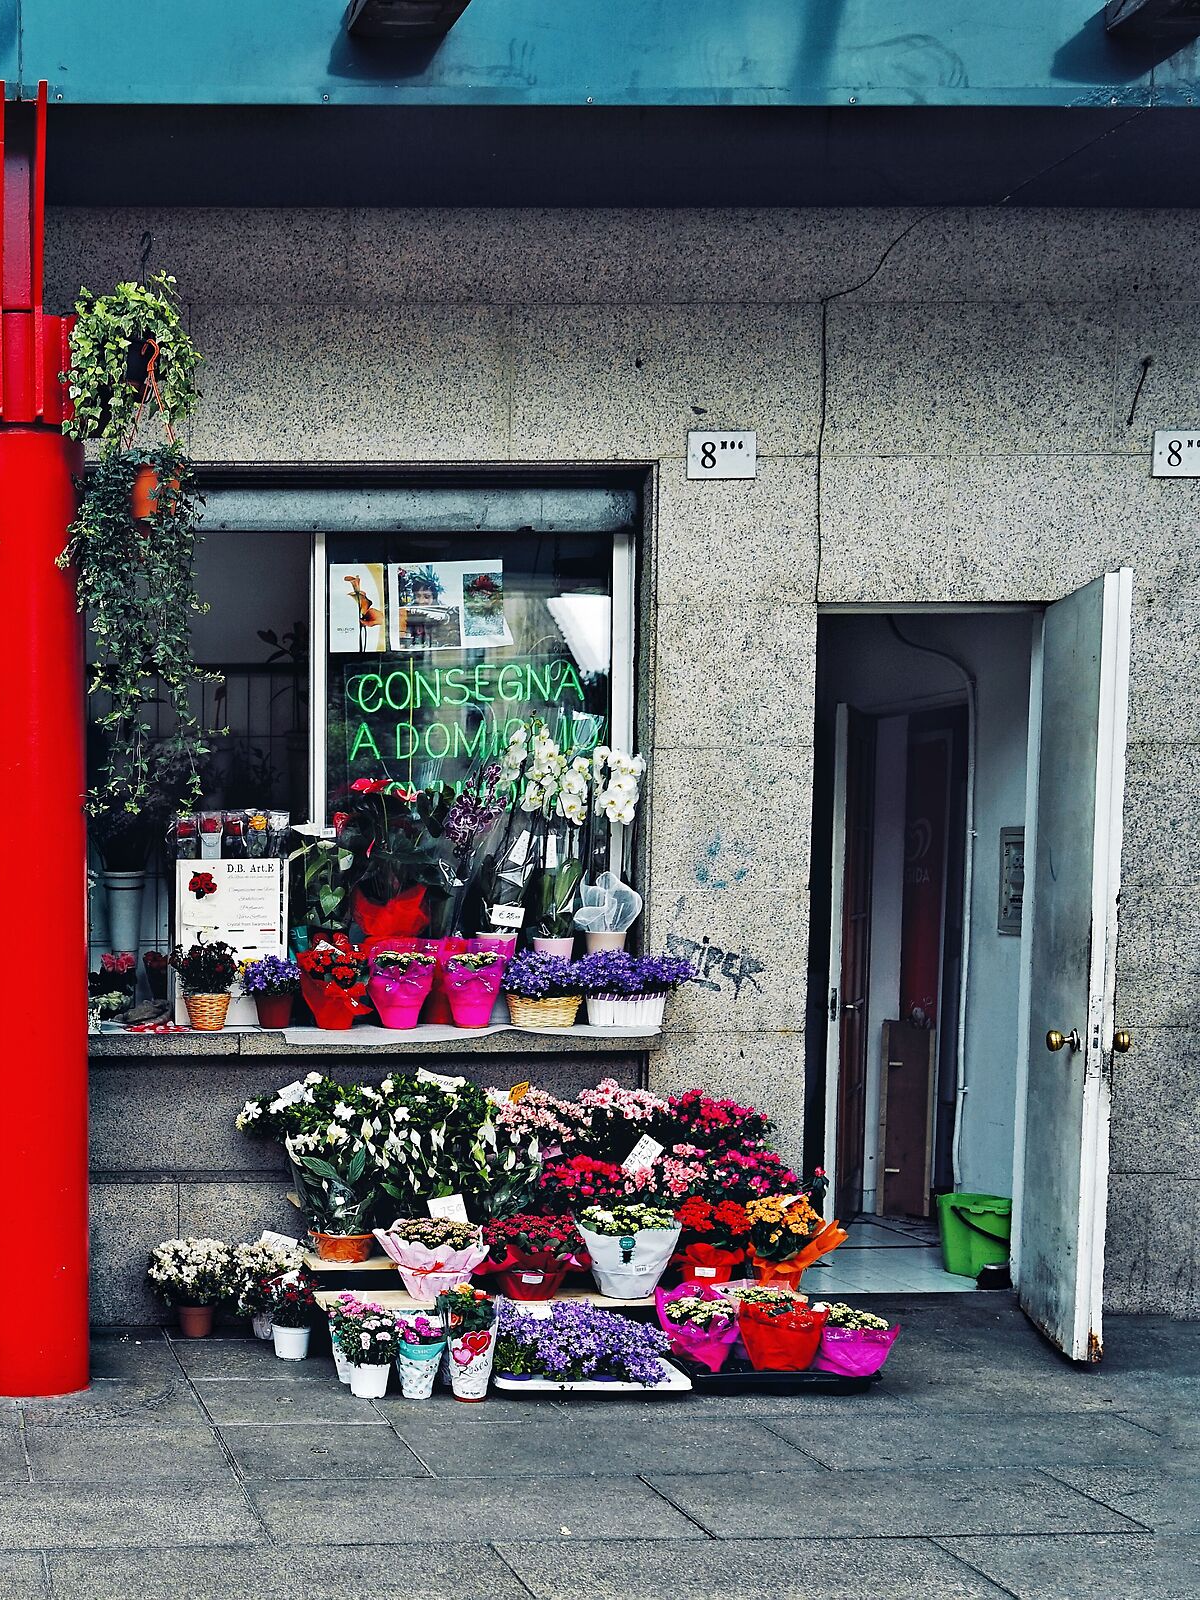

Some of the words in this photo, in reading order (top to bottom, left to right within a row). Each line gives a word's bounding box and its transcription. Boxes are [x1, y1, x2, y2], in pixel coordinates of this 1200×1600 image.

[701, 441, 717, 469] 8
[1166, 439, 1183, 467] 8
[357, 661, 585, 713] CONSEGNA
[350, 721, 381, 761] A
